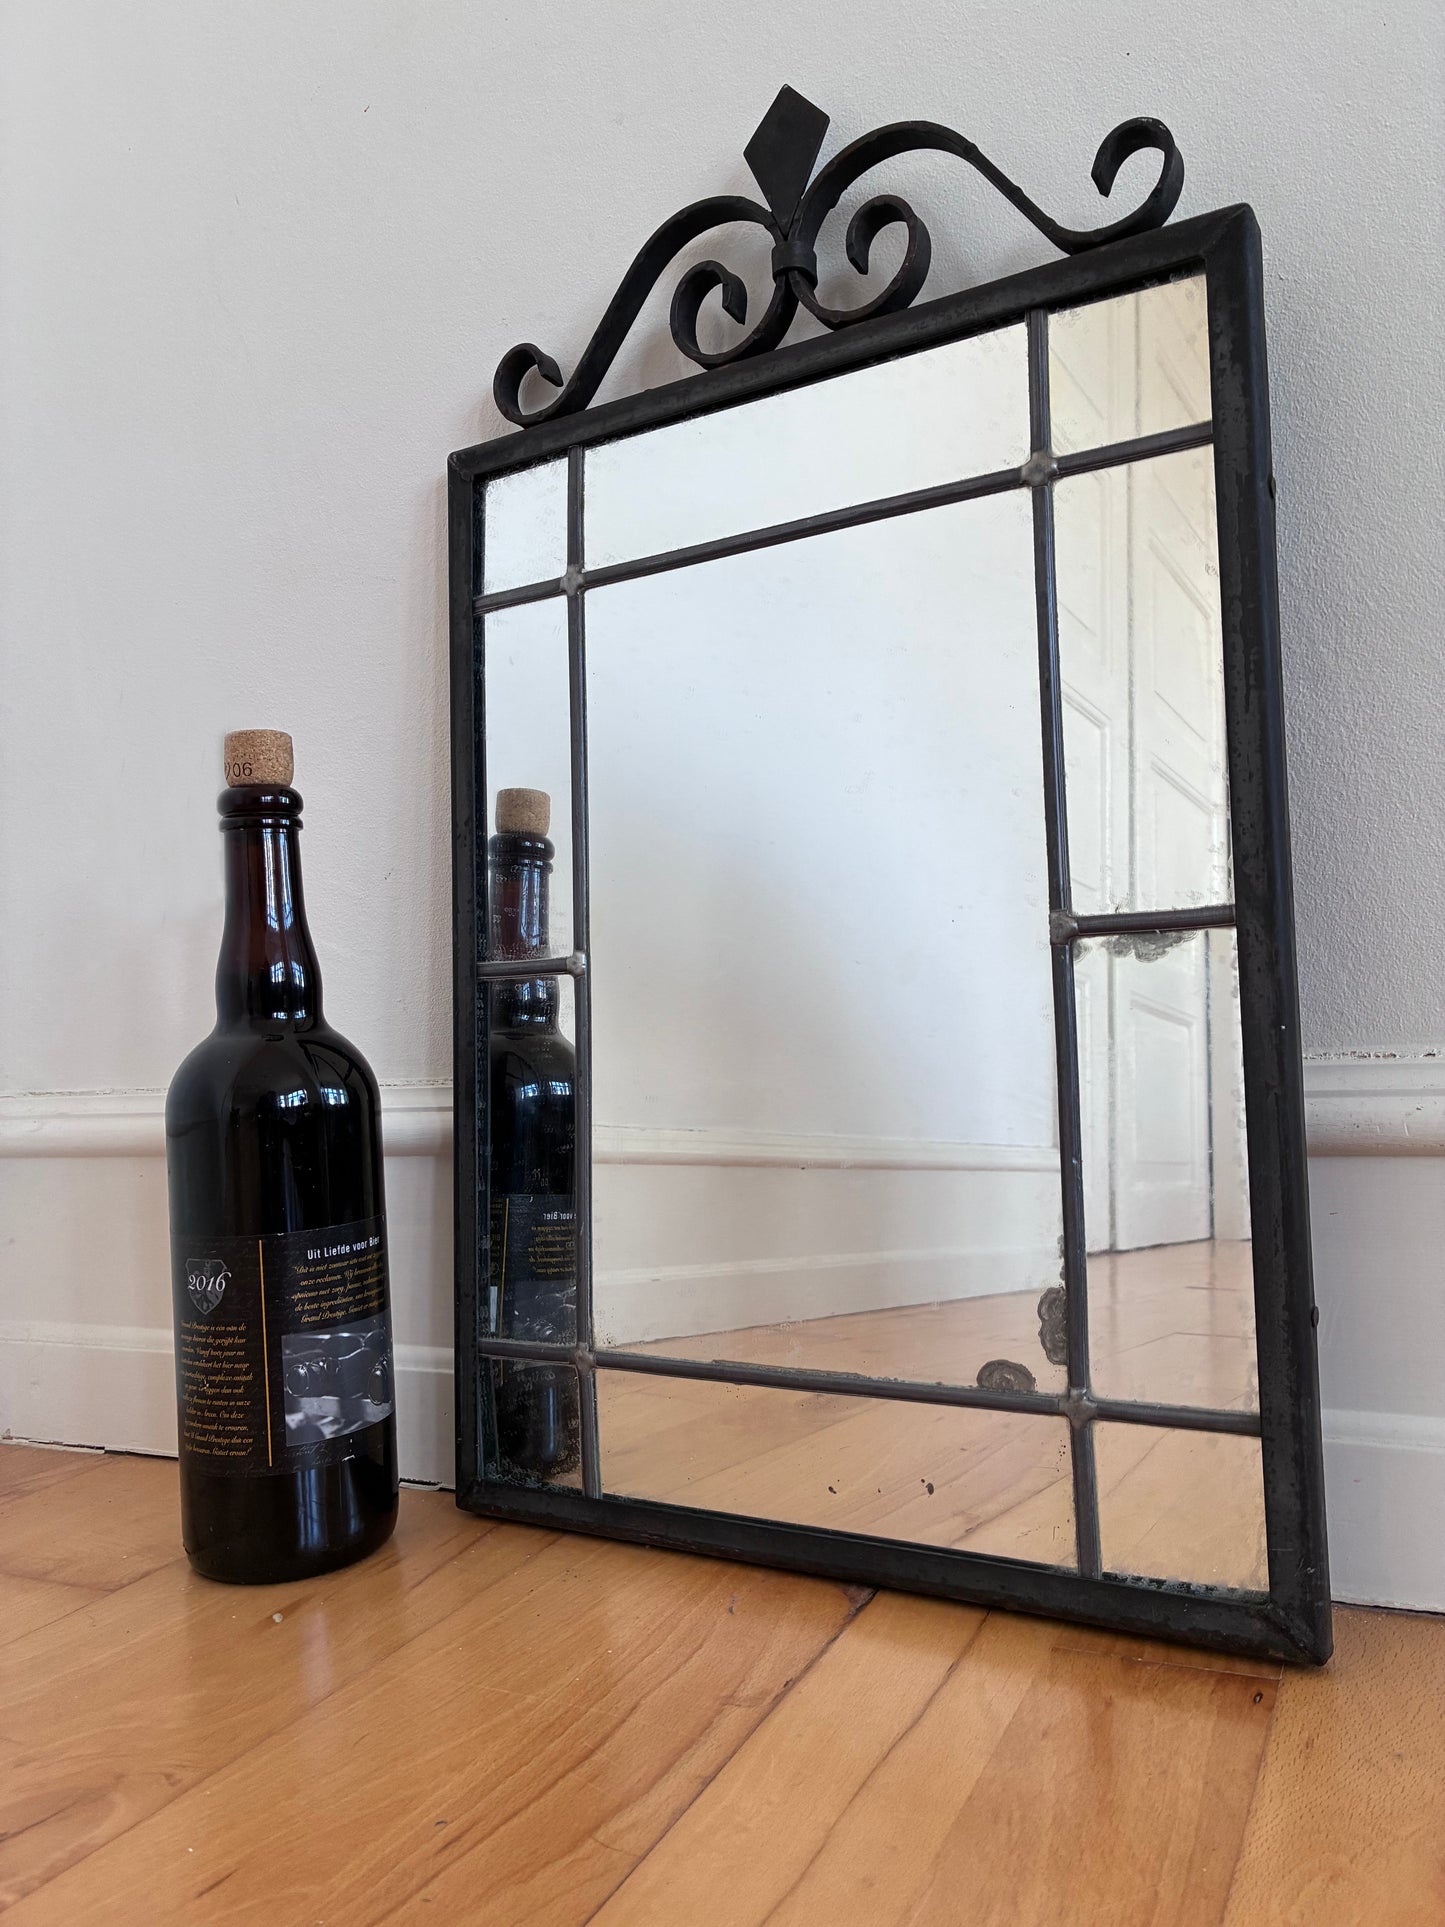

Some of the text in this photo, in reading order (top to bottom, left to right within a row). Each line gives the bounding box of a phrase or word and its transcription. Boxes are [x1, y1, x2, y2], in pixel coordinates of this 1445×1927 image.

[307, 1236, 380, 1260] Uit Liefde voor Bier
[187, 1272, 232, 1292] 2016
